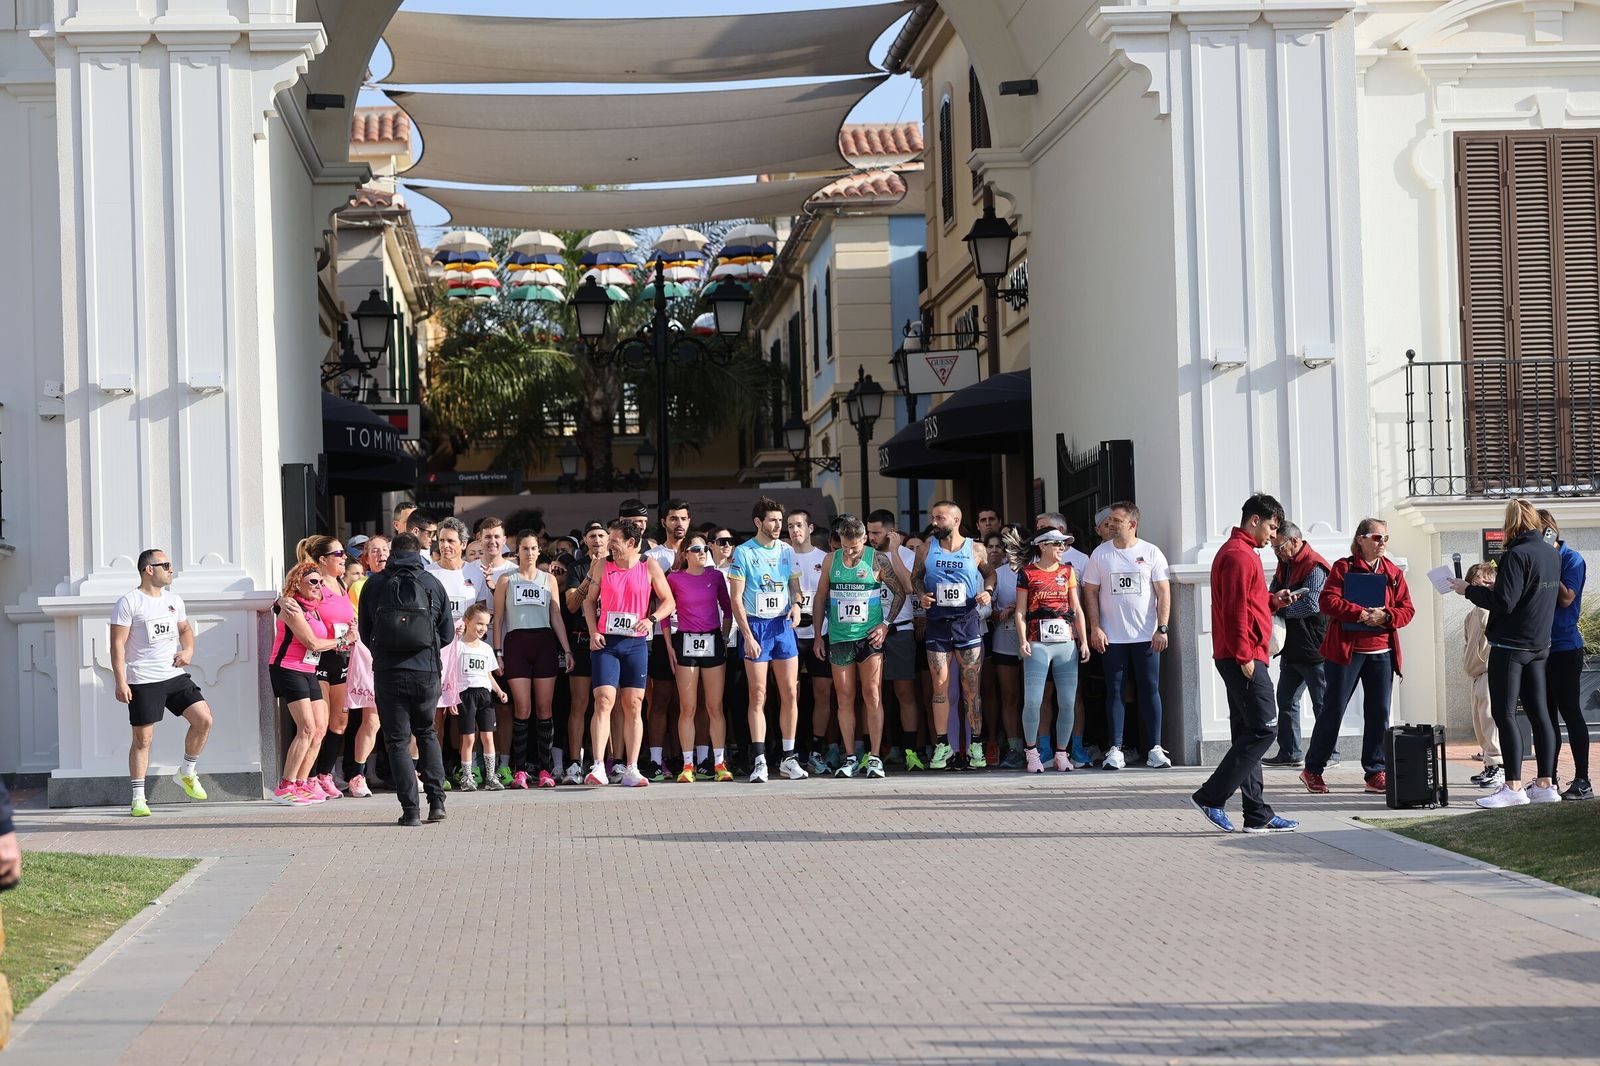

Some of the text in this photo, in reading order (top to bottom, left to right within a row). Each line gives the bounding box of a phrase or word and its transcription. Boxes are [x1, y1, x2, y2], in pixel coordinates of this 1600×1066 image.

[346, 427, 397, 451] TOMMY
[458, 473, 479, 481] Guest
[935, 560, 964, 569] ERESO
[835, 583, 866, 591] ATLETISMO
[1119, 577, 1132, 588] 30
[522, 588, 540, 599] 408
[944, 589, 960, 600] 169
[765, 597, 779, 608] 161
[845, 605, 861, 616] 179
[614, 617, 631, 629] 240
[693, 639, 706, 650] 84
[469, 658, 485, 670] 503
